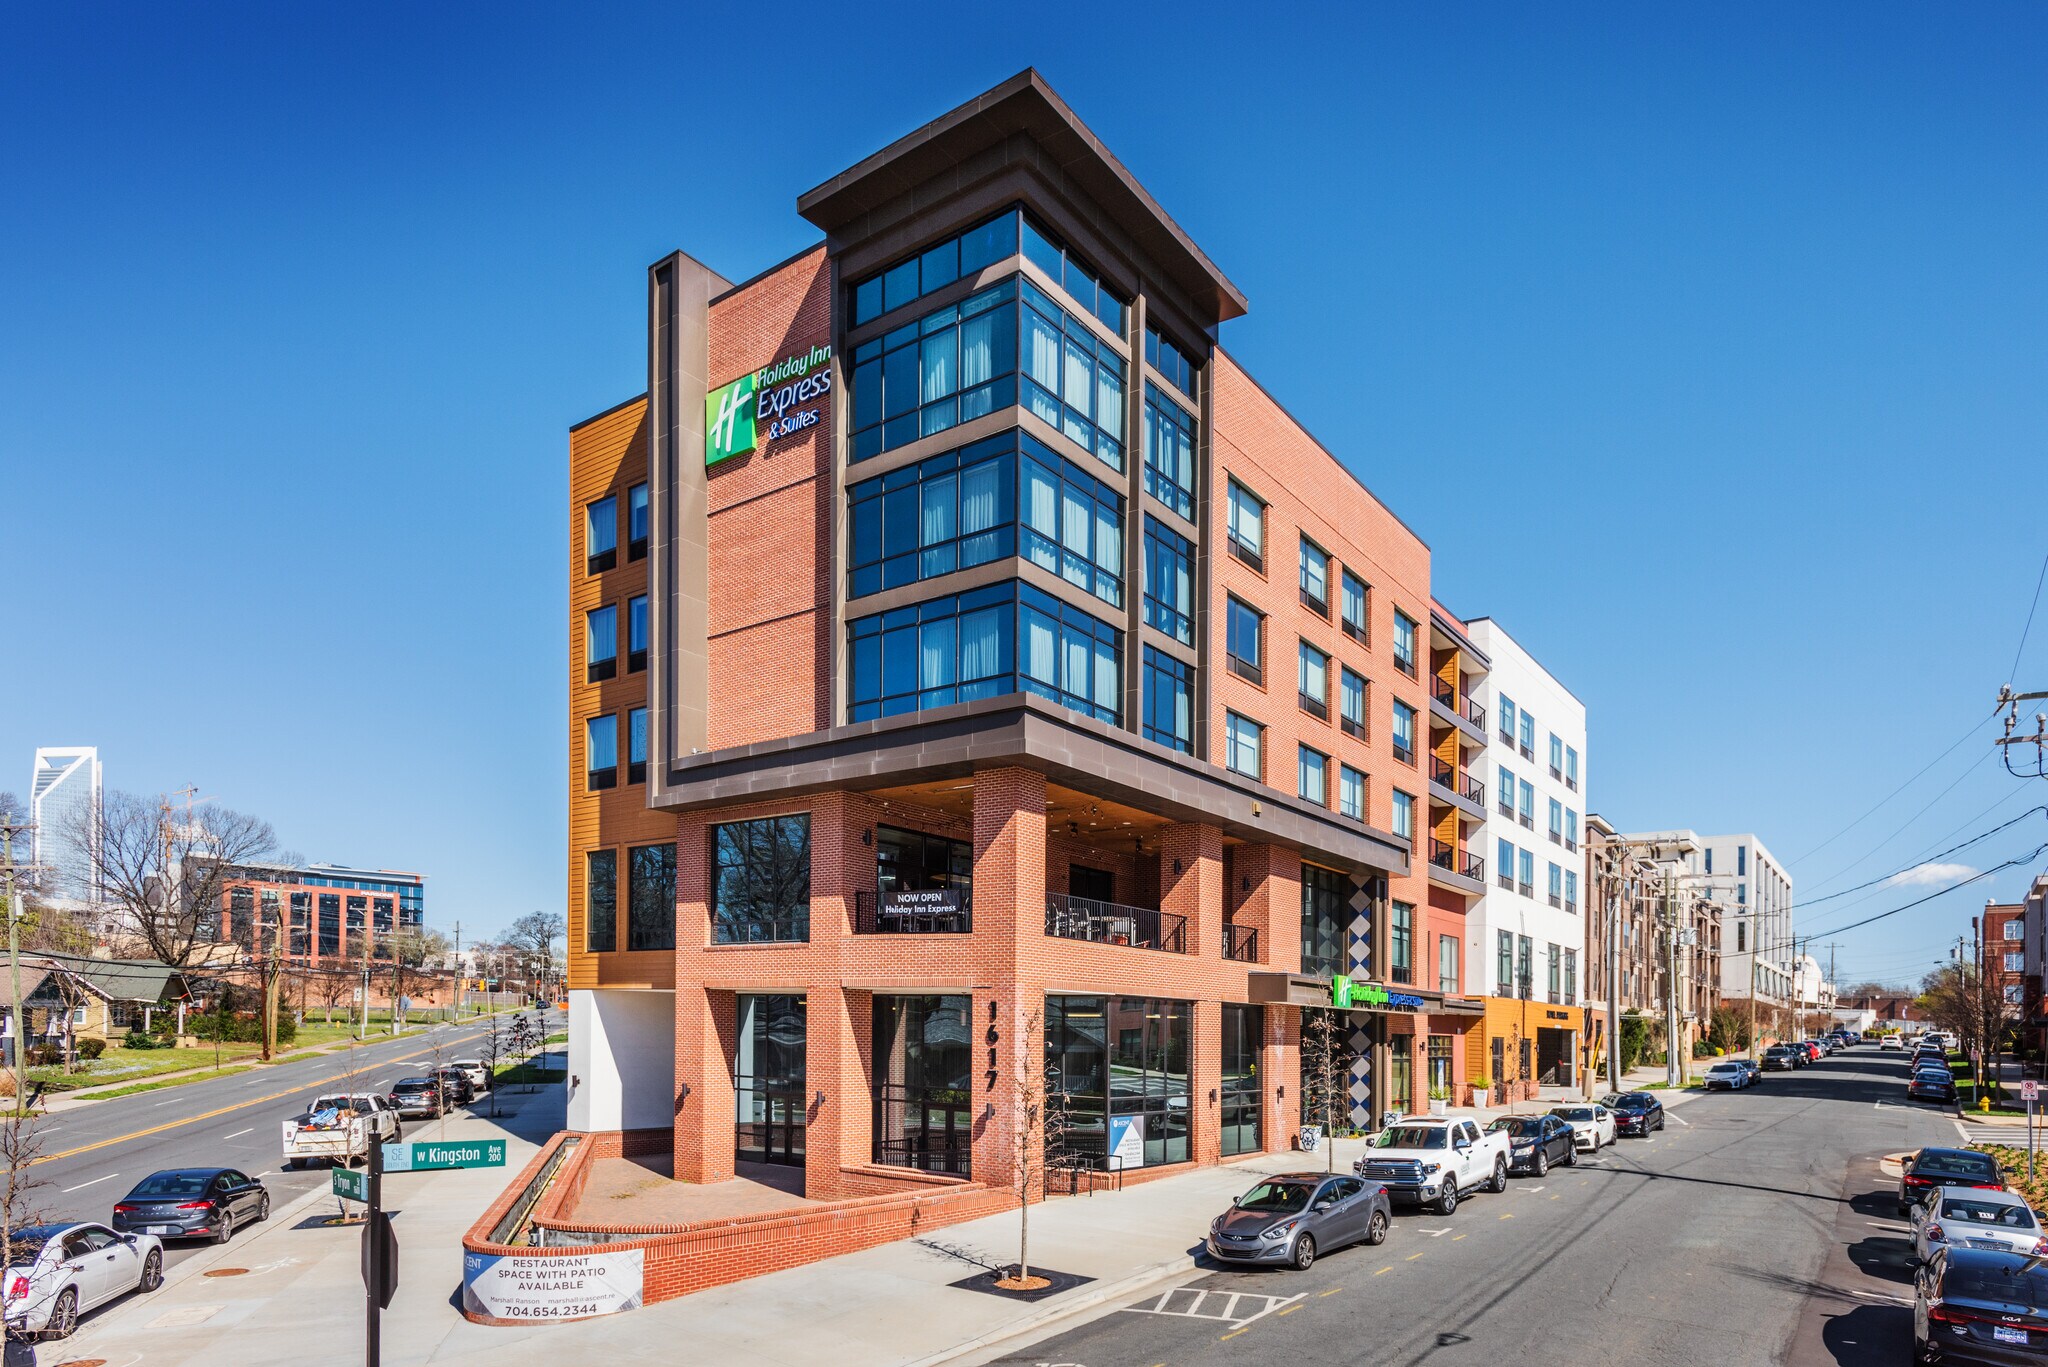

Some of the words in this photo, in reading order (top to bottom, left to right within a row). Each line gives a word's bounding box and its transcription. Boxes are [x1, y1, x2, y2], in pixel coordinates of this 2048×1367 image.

[757, 355, 808, 389] Holiday
[809, 345, 831, 366] Inn
[757, 369, 831, 419] Express
[769, 422, 779, 440] &
[780, 409, 818, 436] Suites
[897, 894, 919, 903] NOW
[921, 893, 942, 902] OPEN
[885, 905, 912, 915] Holiday
[914, 905, 926, 913] Inn
[928, 904, 956, 915] Express
[985, 1001, 999, 1092] 1617
[488, 1145, 502, 1153] Ave
[429, 1148, 480, 1165] Kingston
[488, 1153, 502, 1162] 200
[337, 1174, 350, 1192] Tryon
[513, 1257, 590, 1268] RESTAURANT
[499, 1270, 532, 1279] SPACE
[536, 1271, 567, 1279] WITH
[571, 1268, 606, 1278] PATIO
[518, 1281, 583, 1291] AVAILABLE
[490, 1296, 514, 1304] Marshall
[505, 1304, 597, 1317] 704.654.2344
